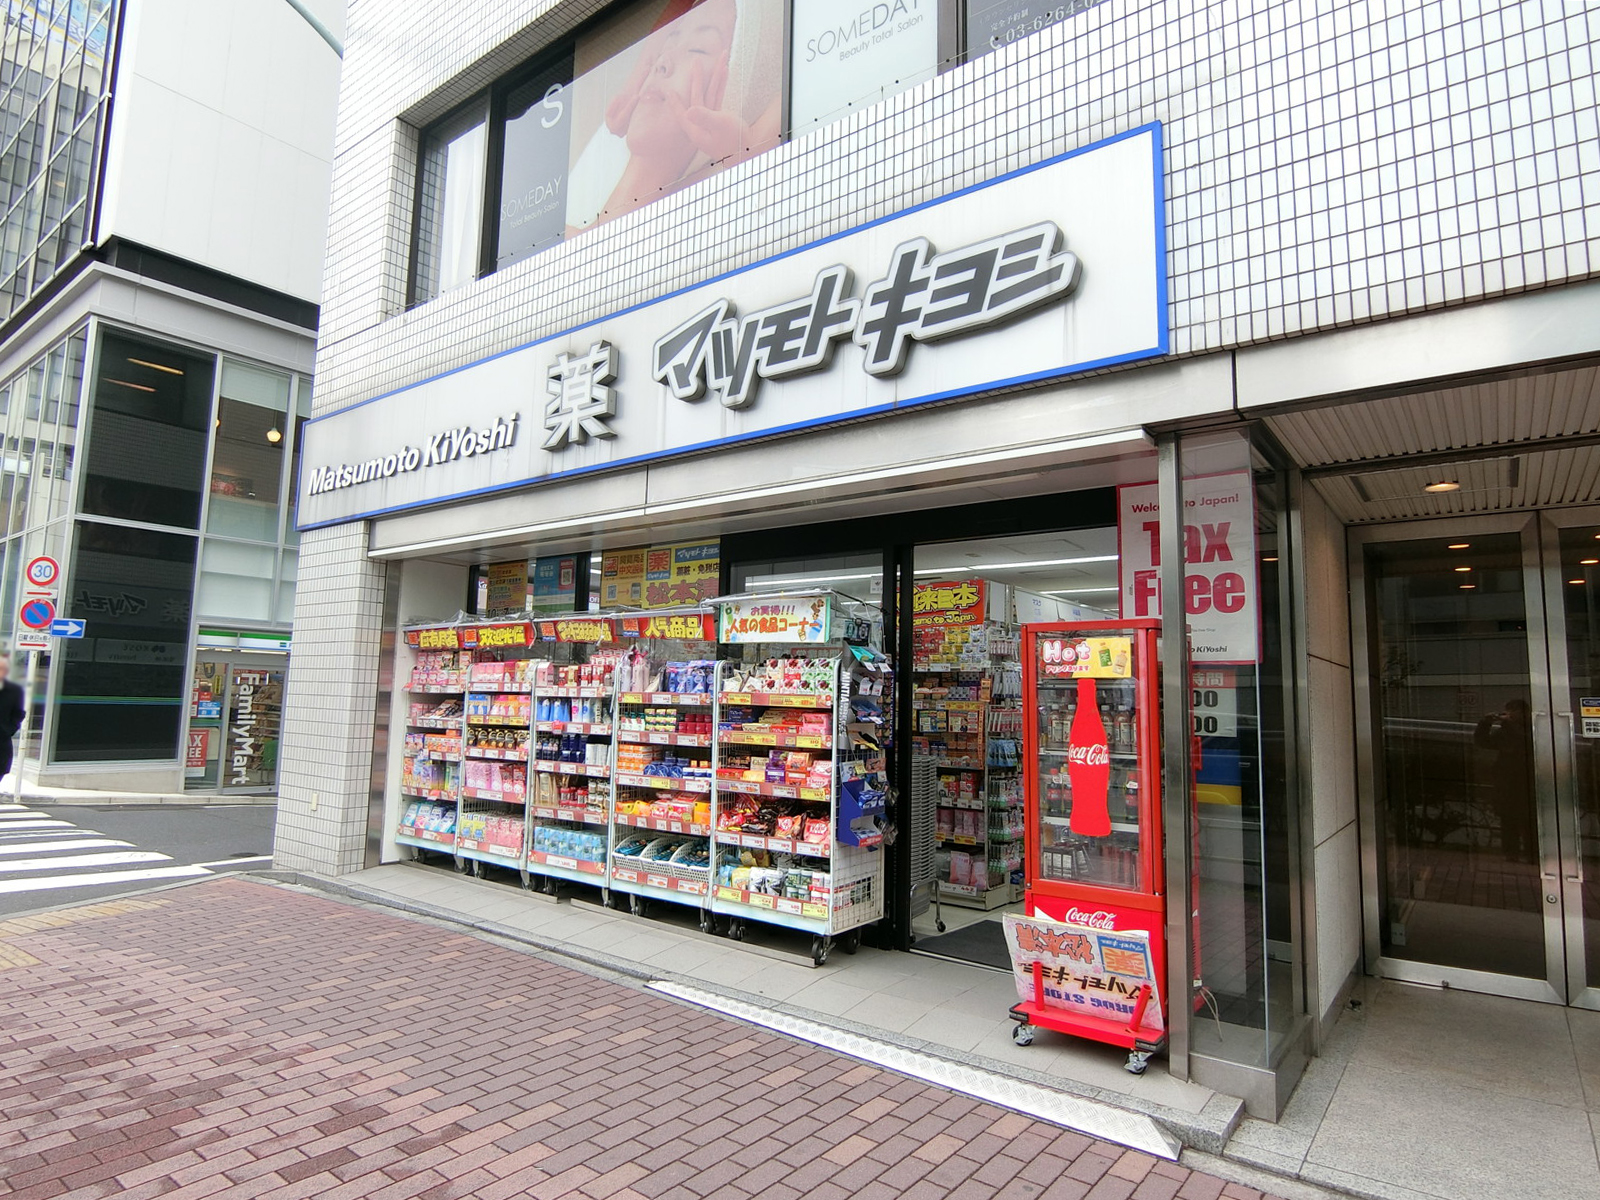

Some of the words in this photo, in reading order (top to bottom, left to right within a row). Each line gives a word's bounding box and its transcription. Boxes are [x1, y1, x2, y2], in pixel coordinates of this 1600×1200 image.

[839, 41, 870, 61] Beauty
[872, 27, 893, 46] Total
[897, 14, 923, 33] Salon
[541, 83, 563, 128] S
[500, 175, 562, 221] SOMEDAY
[524, 206, 543, 223] Beauty
[543, 201, 560, 215] Salon
[541, 341, 618, 451] 薬
[652, 221, 1079, 410] マツモトキヨシ
[309, 442, 420, 497] Matsumoto
[423, 412, 520, 468] KiYoshi
[1131, 502, 1160, 514] Welc
[1185, 499, 1196, 508] to
[1199, 493, 1240, 508] Japan!
[34, 564, 53, 579] 30
[912, 583, 980, 613] 来日本
[1134, 569, 1246, 617] Fee
[645, 616, 703, 639] 人气商品
[730, 617, 820, 634] 人気の食品コーナー
[945, 610, 976, 624] Japan
[1043, 640, 1091, 663] Hot
[1196, 645, 1228, 654] KiYoshi
[1045, 665, 1090, 675] ドリンクあります
[840, 671, 851, 703] MINTIA
[231, 673, 260, 785] FamilyMart
[1069, 743, 1110, 765] Coca-Cola
[1065, 907, 1117, 930] Coca-Cola
